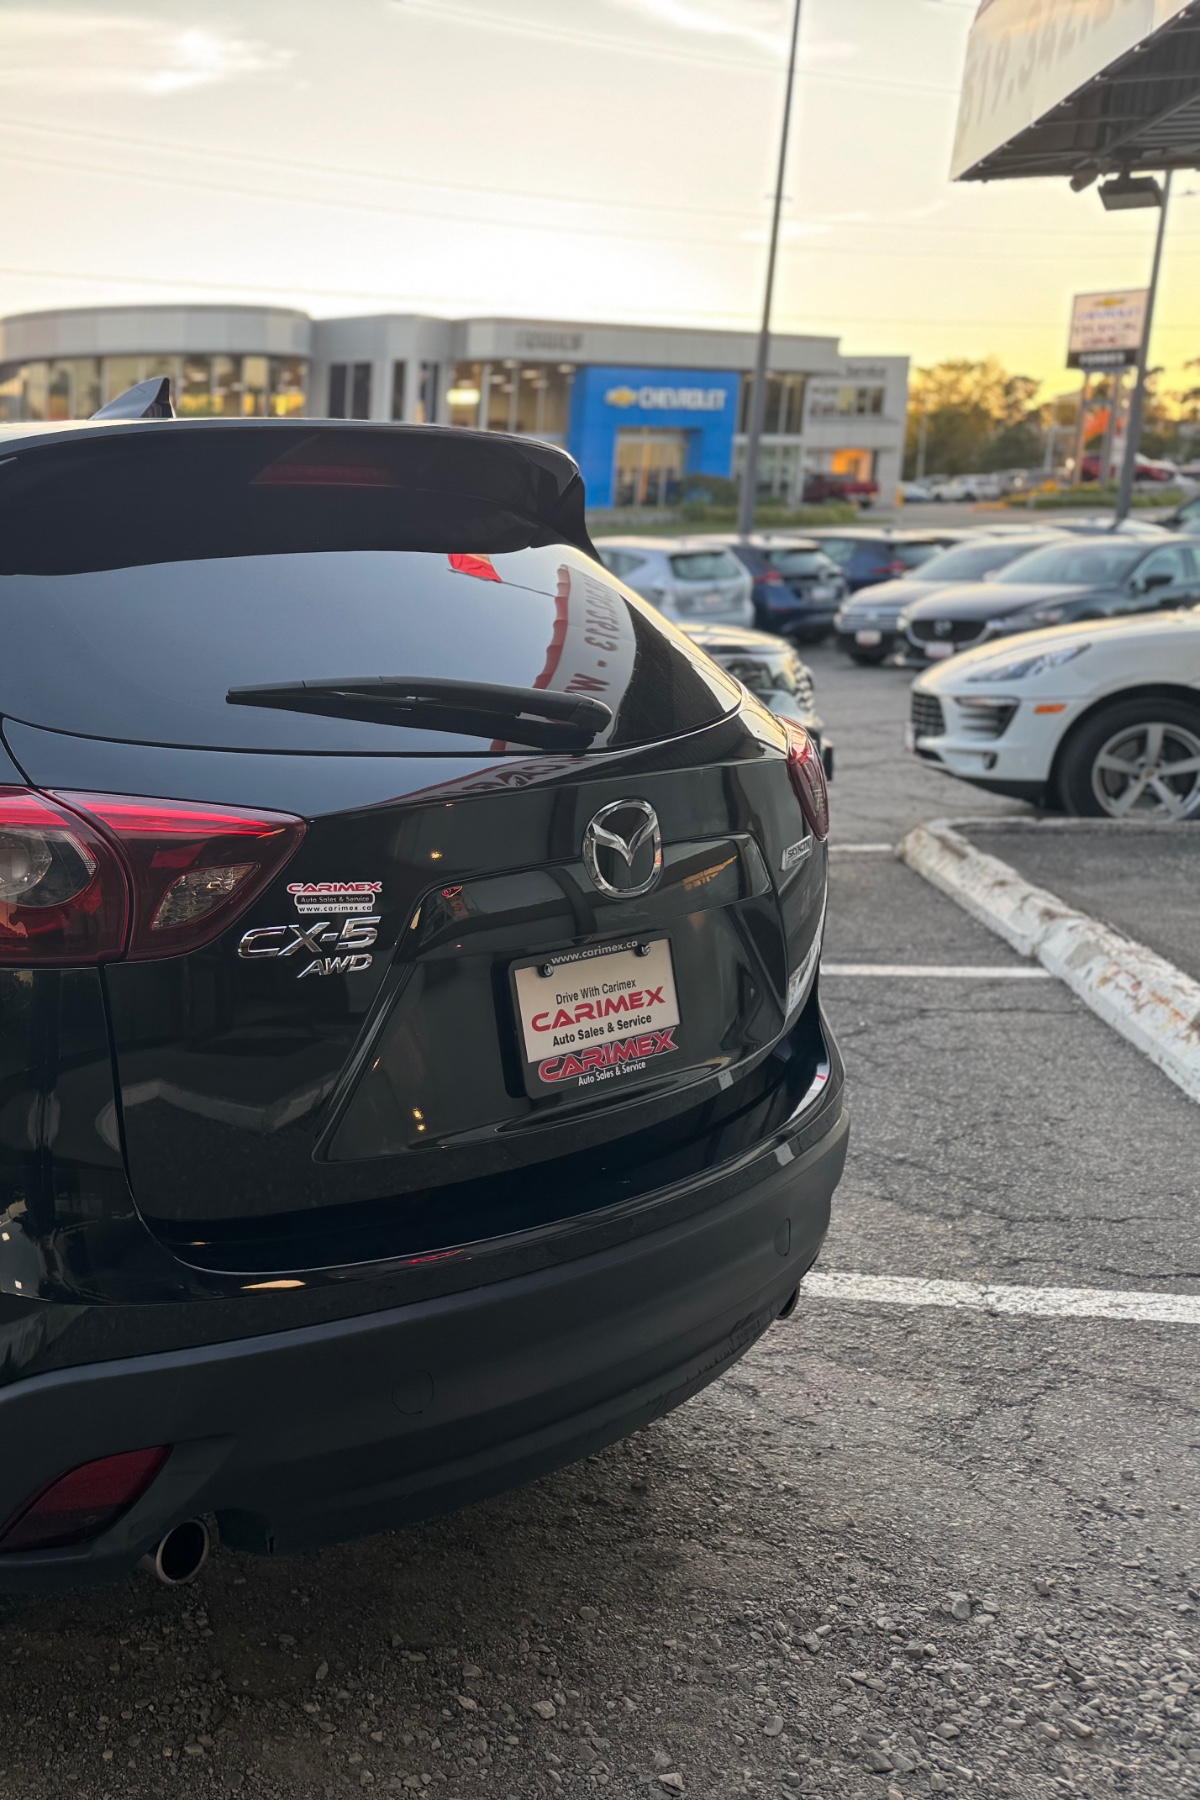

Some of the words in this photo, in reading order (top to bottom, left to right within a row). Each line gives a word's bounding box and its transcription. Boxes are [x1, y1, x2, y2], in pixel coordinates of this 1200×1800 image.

[637, 385, 727, 411] CHEVROLET
[287, 882, 382, 893] CARIMEX
[346, 895, 370, 903] Service
[298, 904, 372, 912] www.carimex.ca
[238, 916, 382, 958] CX-5
[551, 940, 638, 964] www.carimex.ca
[297, 954, 372, 979] AWD
[555, 992, 579, 1005] Drive
[580, 986, 600, 999] With
[602, 979, 637, 994] Carimex
[531, 986, 666, 1032] CARIMEX
[552, 1034, 576, 1047] Auto
[577, 1026, 605, 1041] Sales
[607, 1023, 615, 1033] &
[616, 1013, 652, 1031] Service
[538, 1027, 679, 1083] CARIMEX
[578, 1075, 595, 1086] Auto
[596, 1069, 614, 1081] Sales
[615, 1067, 621, 1076] &
[622, 1060, 646, 1074] Service
